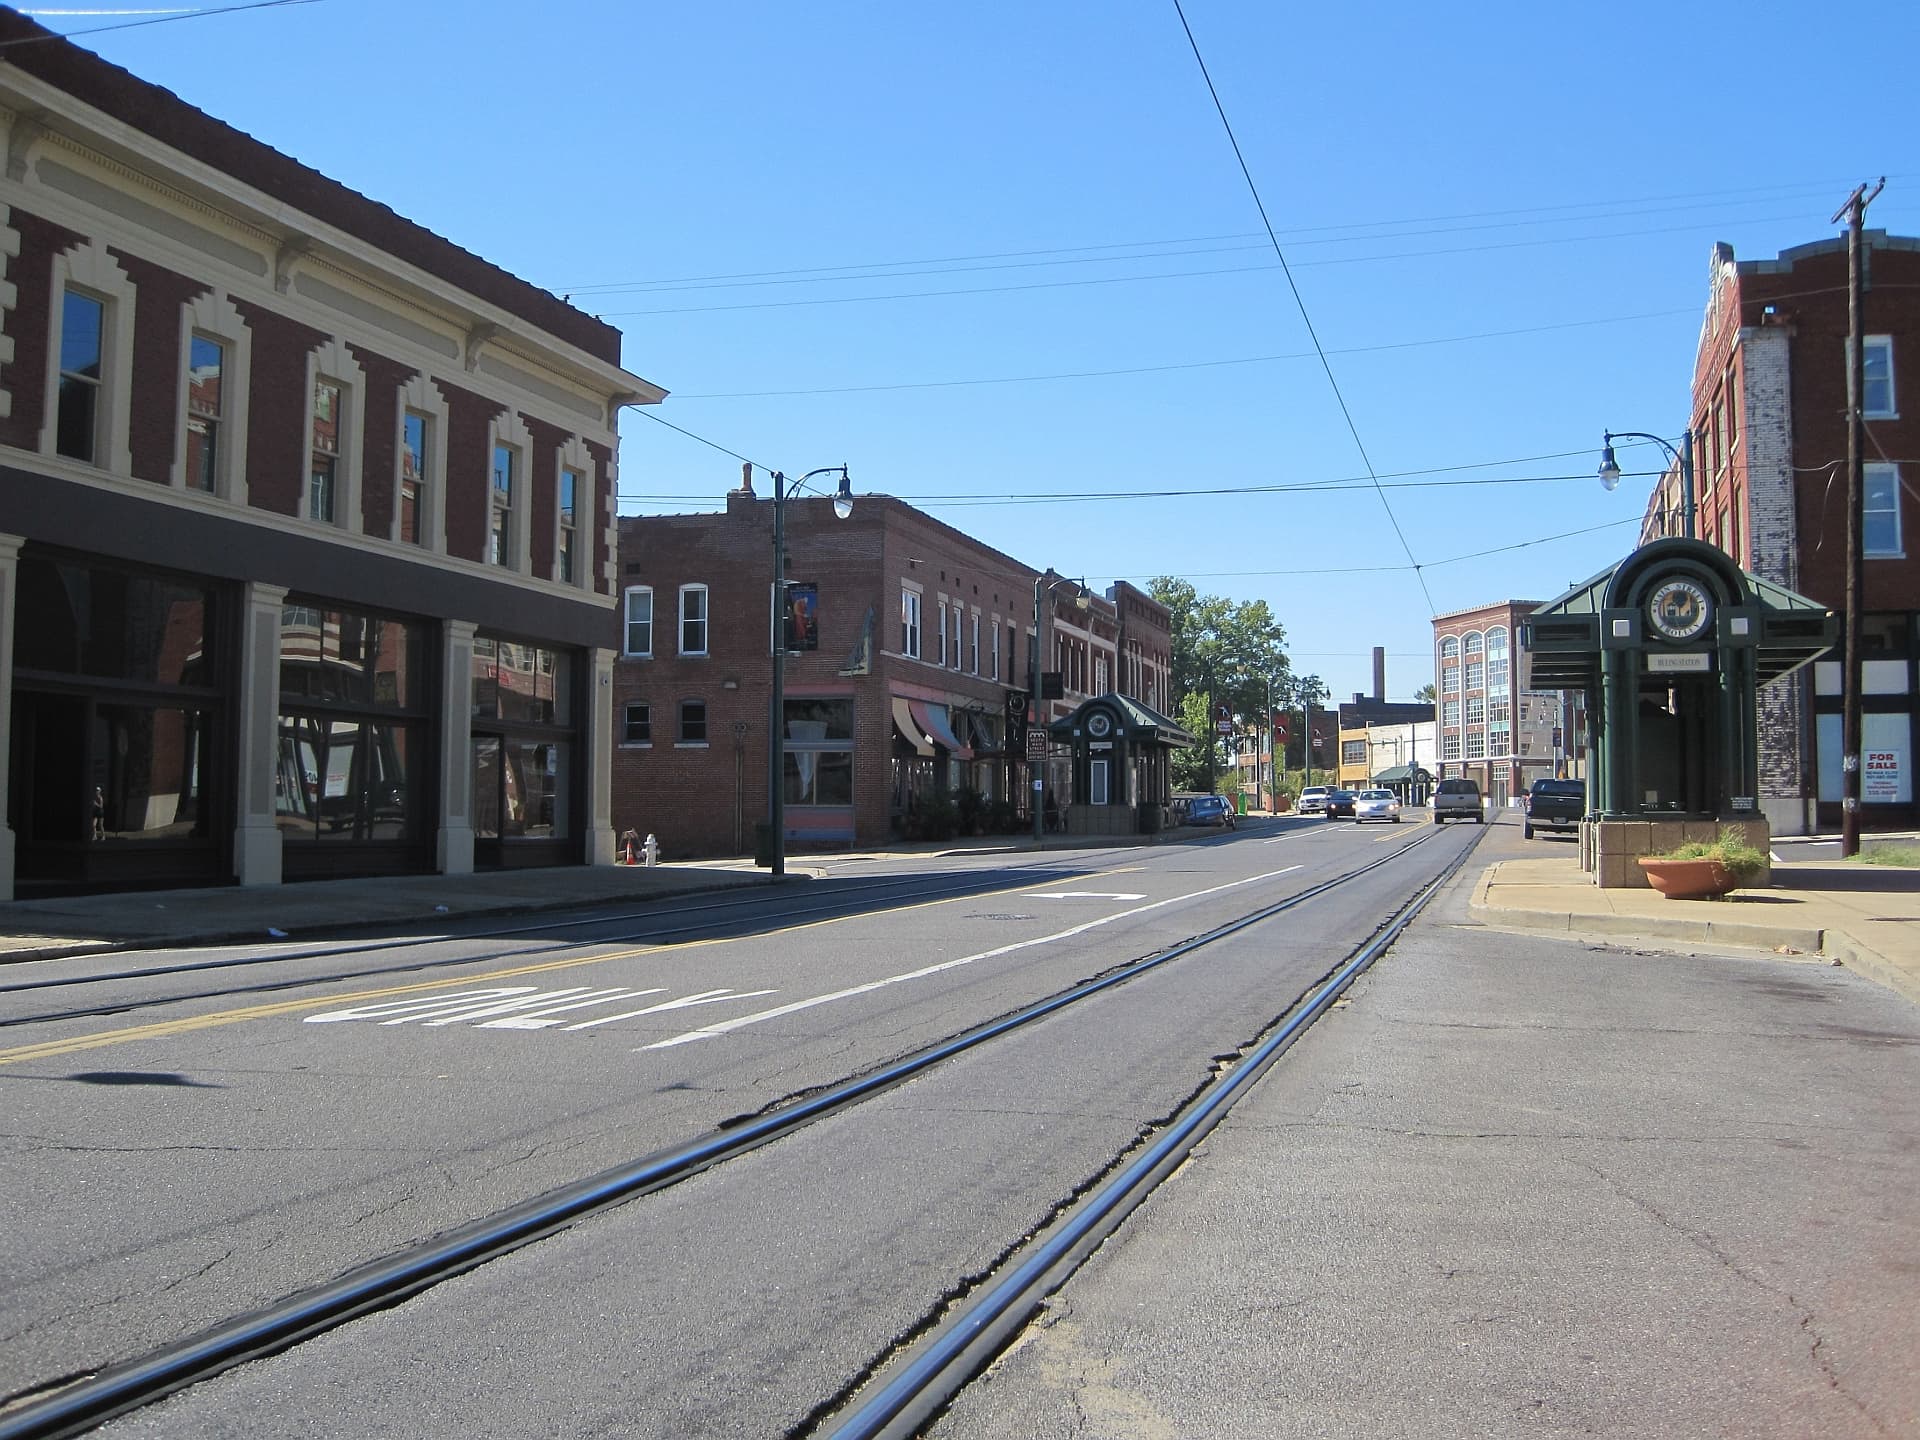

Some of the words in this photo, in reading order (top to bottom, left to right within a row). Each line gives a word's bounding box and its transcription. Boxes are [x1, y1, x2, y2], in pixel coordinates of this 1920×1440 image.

[1653, 586, 1670, 606] MAIN
[1675, 584, 1704, 604] STREET
[1869, 753, 1894, 761] FOR
[303, 986, 780, 1031] ONLY
